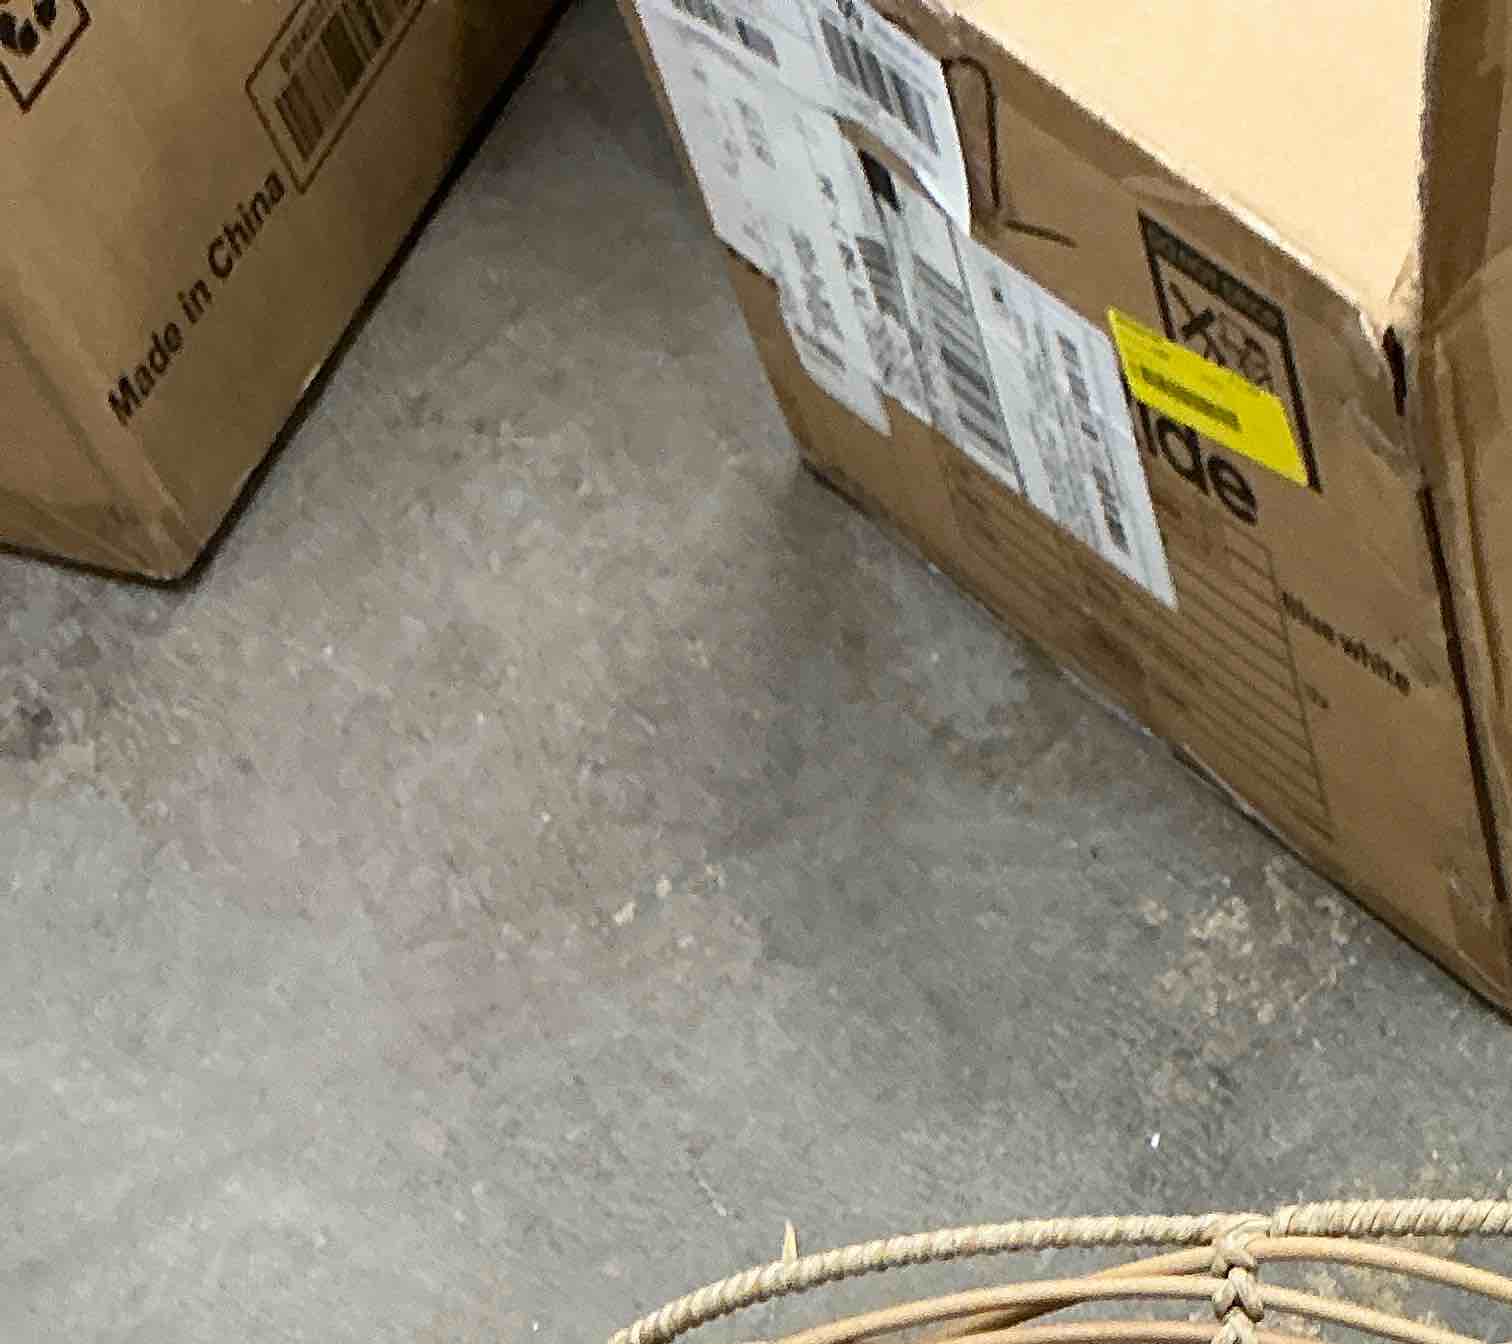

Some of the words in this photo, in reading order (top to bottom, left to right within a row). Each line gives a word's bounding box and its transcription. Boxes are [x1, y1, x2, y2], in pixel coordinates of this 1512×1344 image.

[107, 321, 184, 427] Made
[177, 279, 212, 325] in
[207, 171, 285, 279] China
